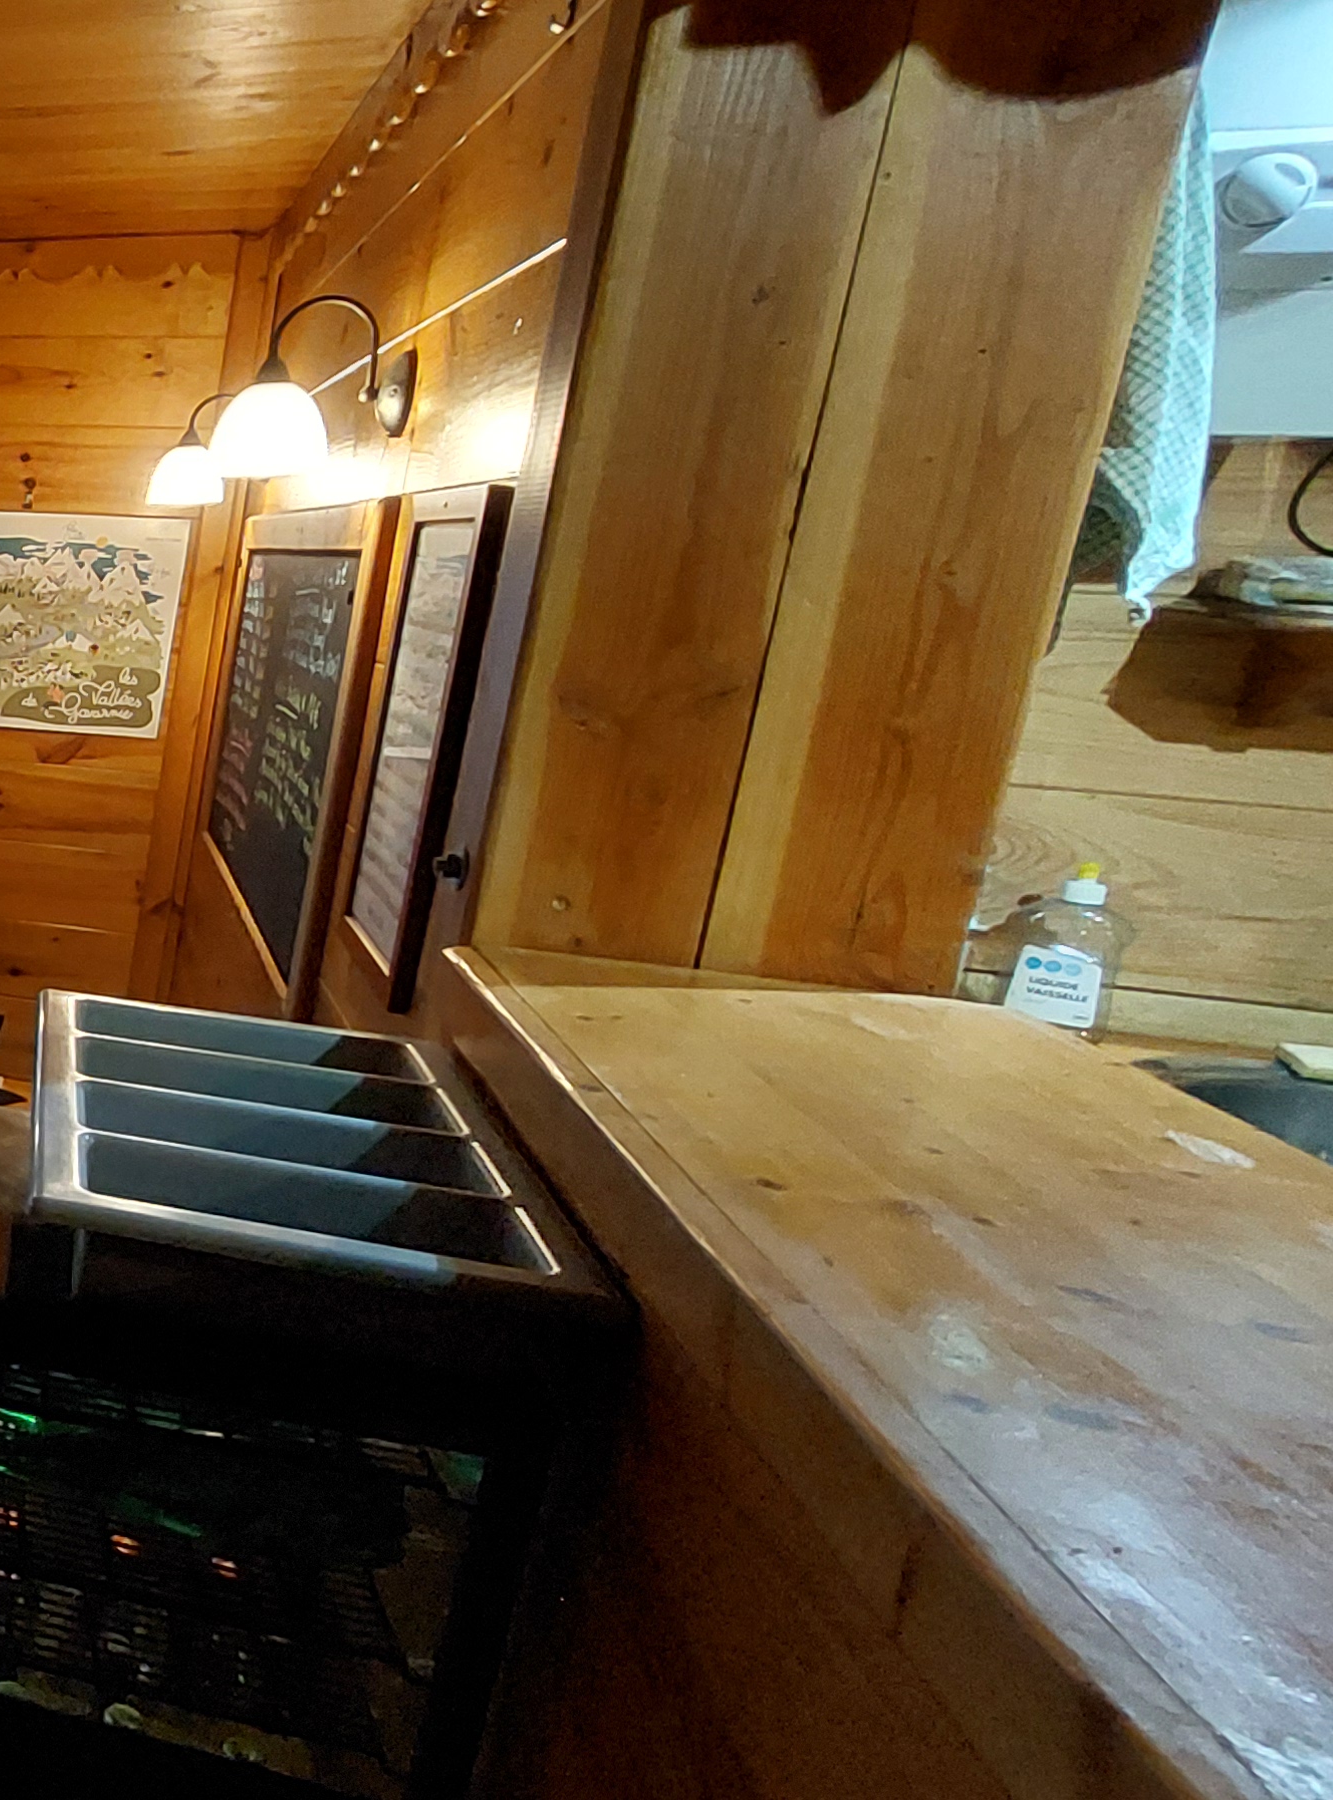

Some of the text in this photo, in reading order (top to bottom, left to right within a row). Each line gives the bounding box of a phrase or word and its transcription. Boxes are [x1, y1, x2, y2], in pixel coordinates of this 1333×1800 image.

[79, 680, 142, 708] Vallées
[1028, 976, 1079, 991] LIQUIDE
[1026, 986, 1090, 1003] VAISSELLE
